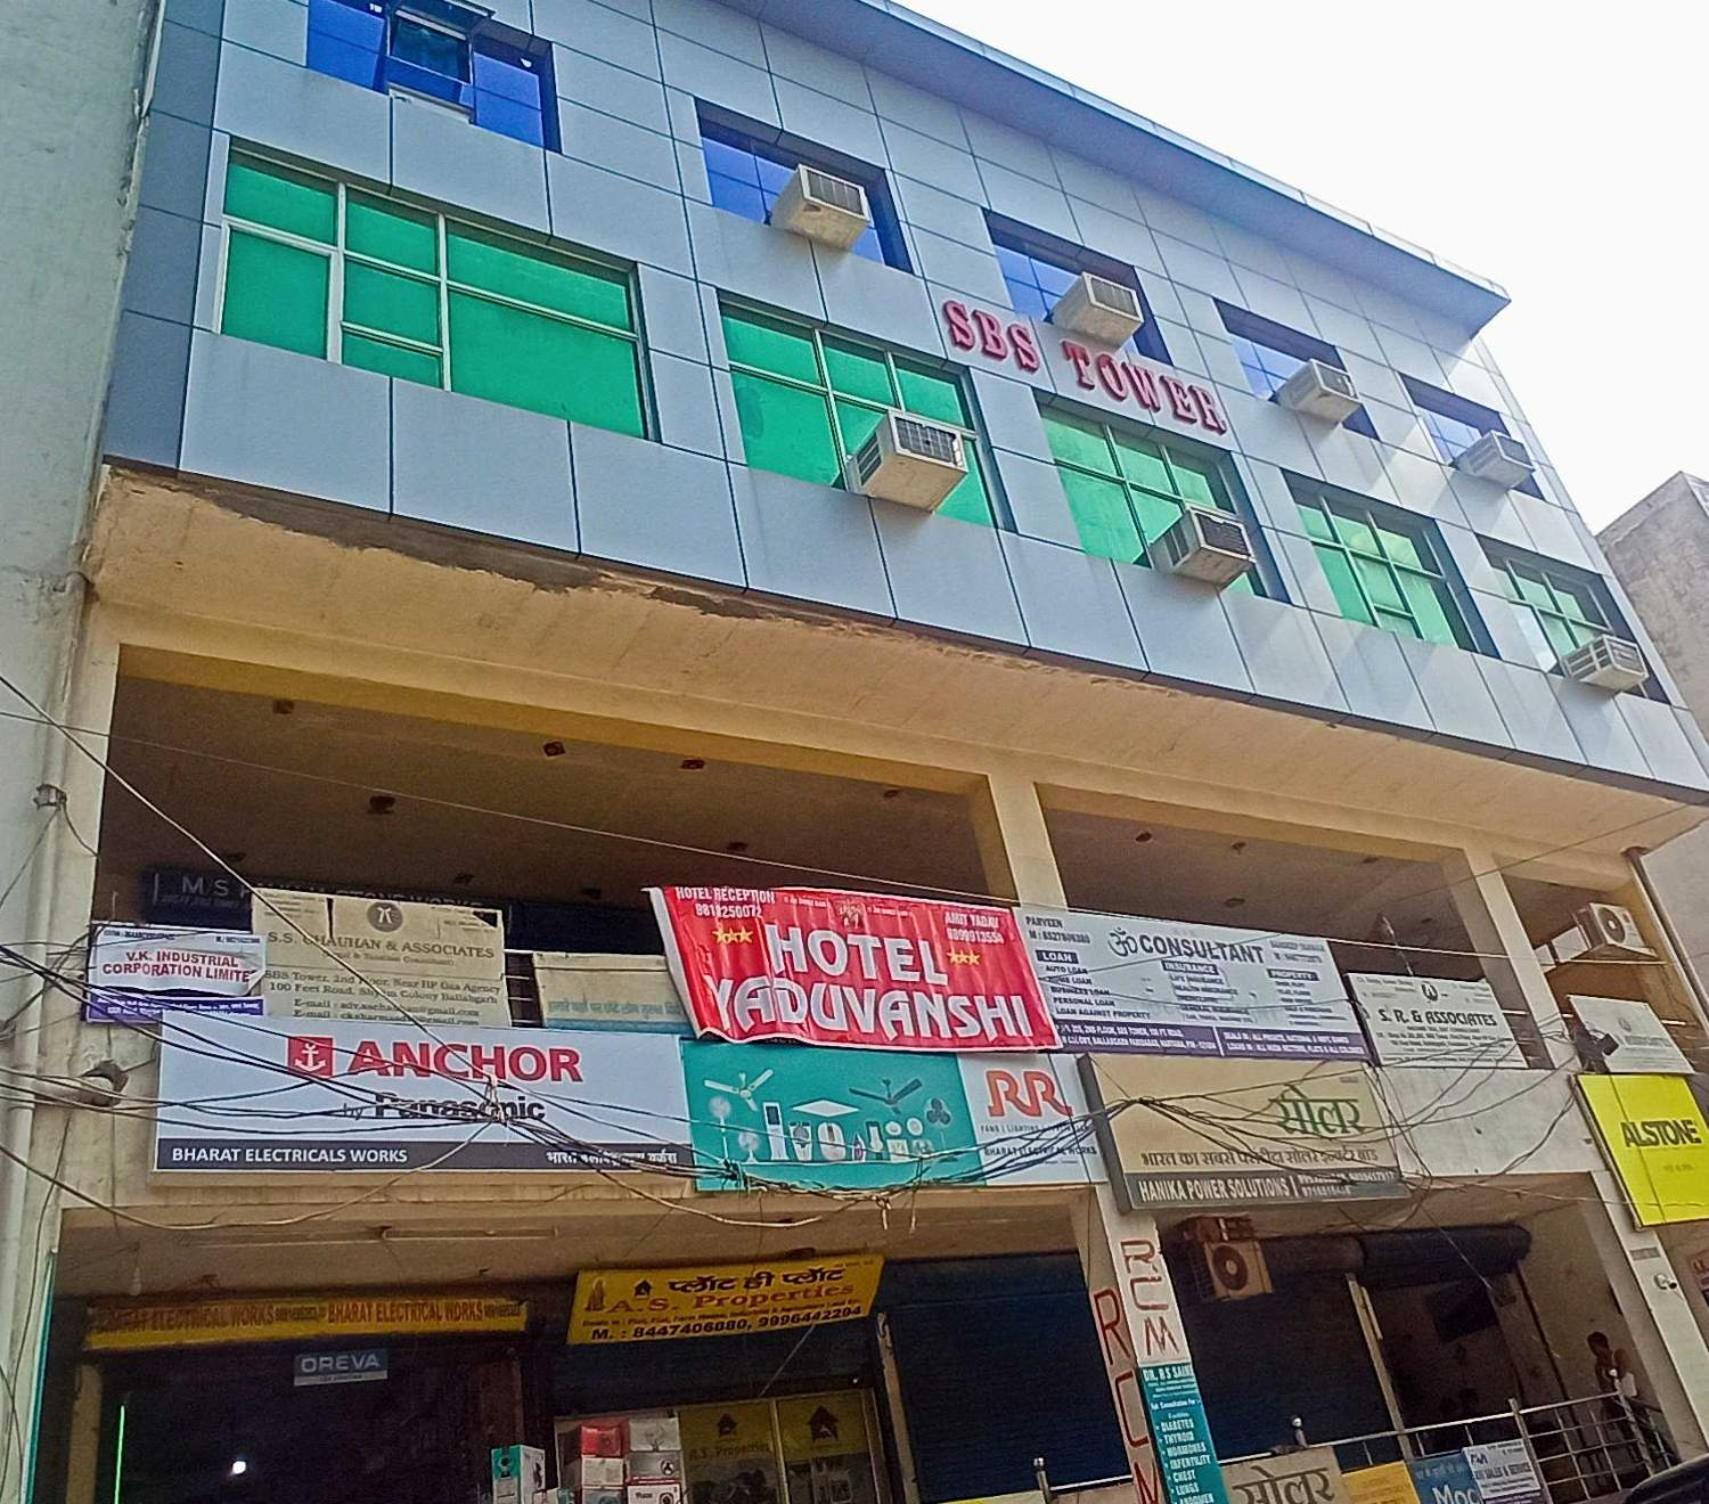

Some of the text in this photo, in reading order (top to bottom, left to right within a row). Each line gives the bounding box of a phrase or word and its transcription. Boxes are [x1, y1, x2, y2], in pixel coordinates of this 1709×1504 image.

[943, 300, 1227, 435] SBS TOWER
[675, 887, 712, 901] HOTEL
[713, 888, 776, 903] RECEPTION
[268, 932, 297, 944] S.S.
[386, 940, 398, 950] &
[402, 942, 494, 959] ASSOCIATES
[765, 924, 948, 987] HOTEL
[1140, 935, 1264, 964] CONSULTANT
[126, 950, 238, 968] V.K. INDUSTRIAL
[1043, 952, 1072, 962] LOAN
[102, 963, 202, 978] CORPORATION
[270, 982, 291, 991] 100
[400, 991, 439, 1002] Colony
[463, 983, 500, 995] Agency
[703, 976, 1034, 1043] YADUVANSHI
[1412, 1011, 1423, 1023] &
[1426, 1011, 1497, 1027] ASSOCIATES
[348, 1040, 583, 1083] ANCHOR
[985, 1070, 1073, 1117] RR
[1620, 1119, 1702, 1148] ALSTONE
[173, 1148, 408, 1163] BHARAT ELECTRICALS WORKS
[1141, 1151, 1177, 1166] भारत
[1179, 1152, 1200, 1166] का
[1139, 1179, 1187, 1202] HANIKA
[1187, 1178, 1228, 1201] POWER
[1228, 1177, 1290, 1200] SOLUTIONS
[607, 1282, 855, 1314] A.S. Properties
[230, 1305, 274, 1327] WORKS
[328, 1302, 373, 1323] BHARAT
[376, 1301, 443, 1322] ELECTRICAL
[446, 1300, 484, 1321] WORKS
[301, 1353, 380, 1373] OREVA
[1173, 1469, 1196, 1483] CHEST
